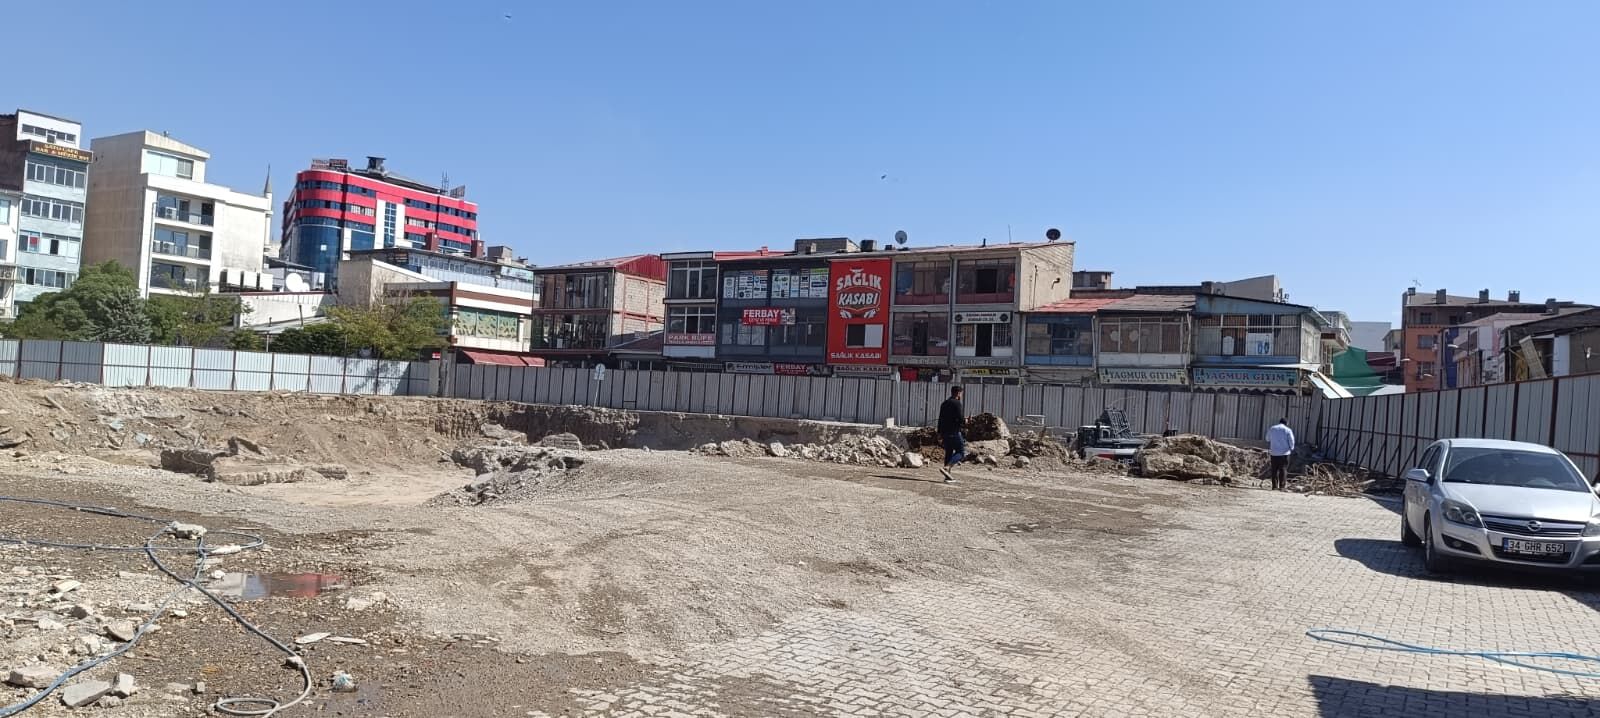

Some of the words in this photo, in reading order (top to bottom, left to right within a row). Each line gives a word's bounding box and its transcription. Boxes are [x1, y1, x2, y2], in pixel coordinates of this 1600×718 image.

[837, 270, 882, 290] SAĞLIK
[838, 293, 879, 306] KASABI
[743, 309, 780, 318] FERBAY
[1509, 540, 1521, 550] 34
[1524, 542, 1542, 551] GHR
[1545, 543, 1563, 553] 652
